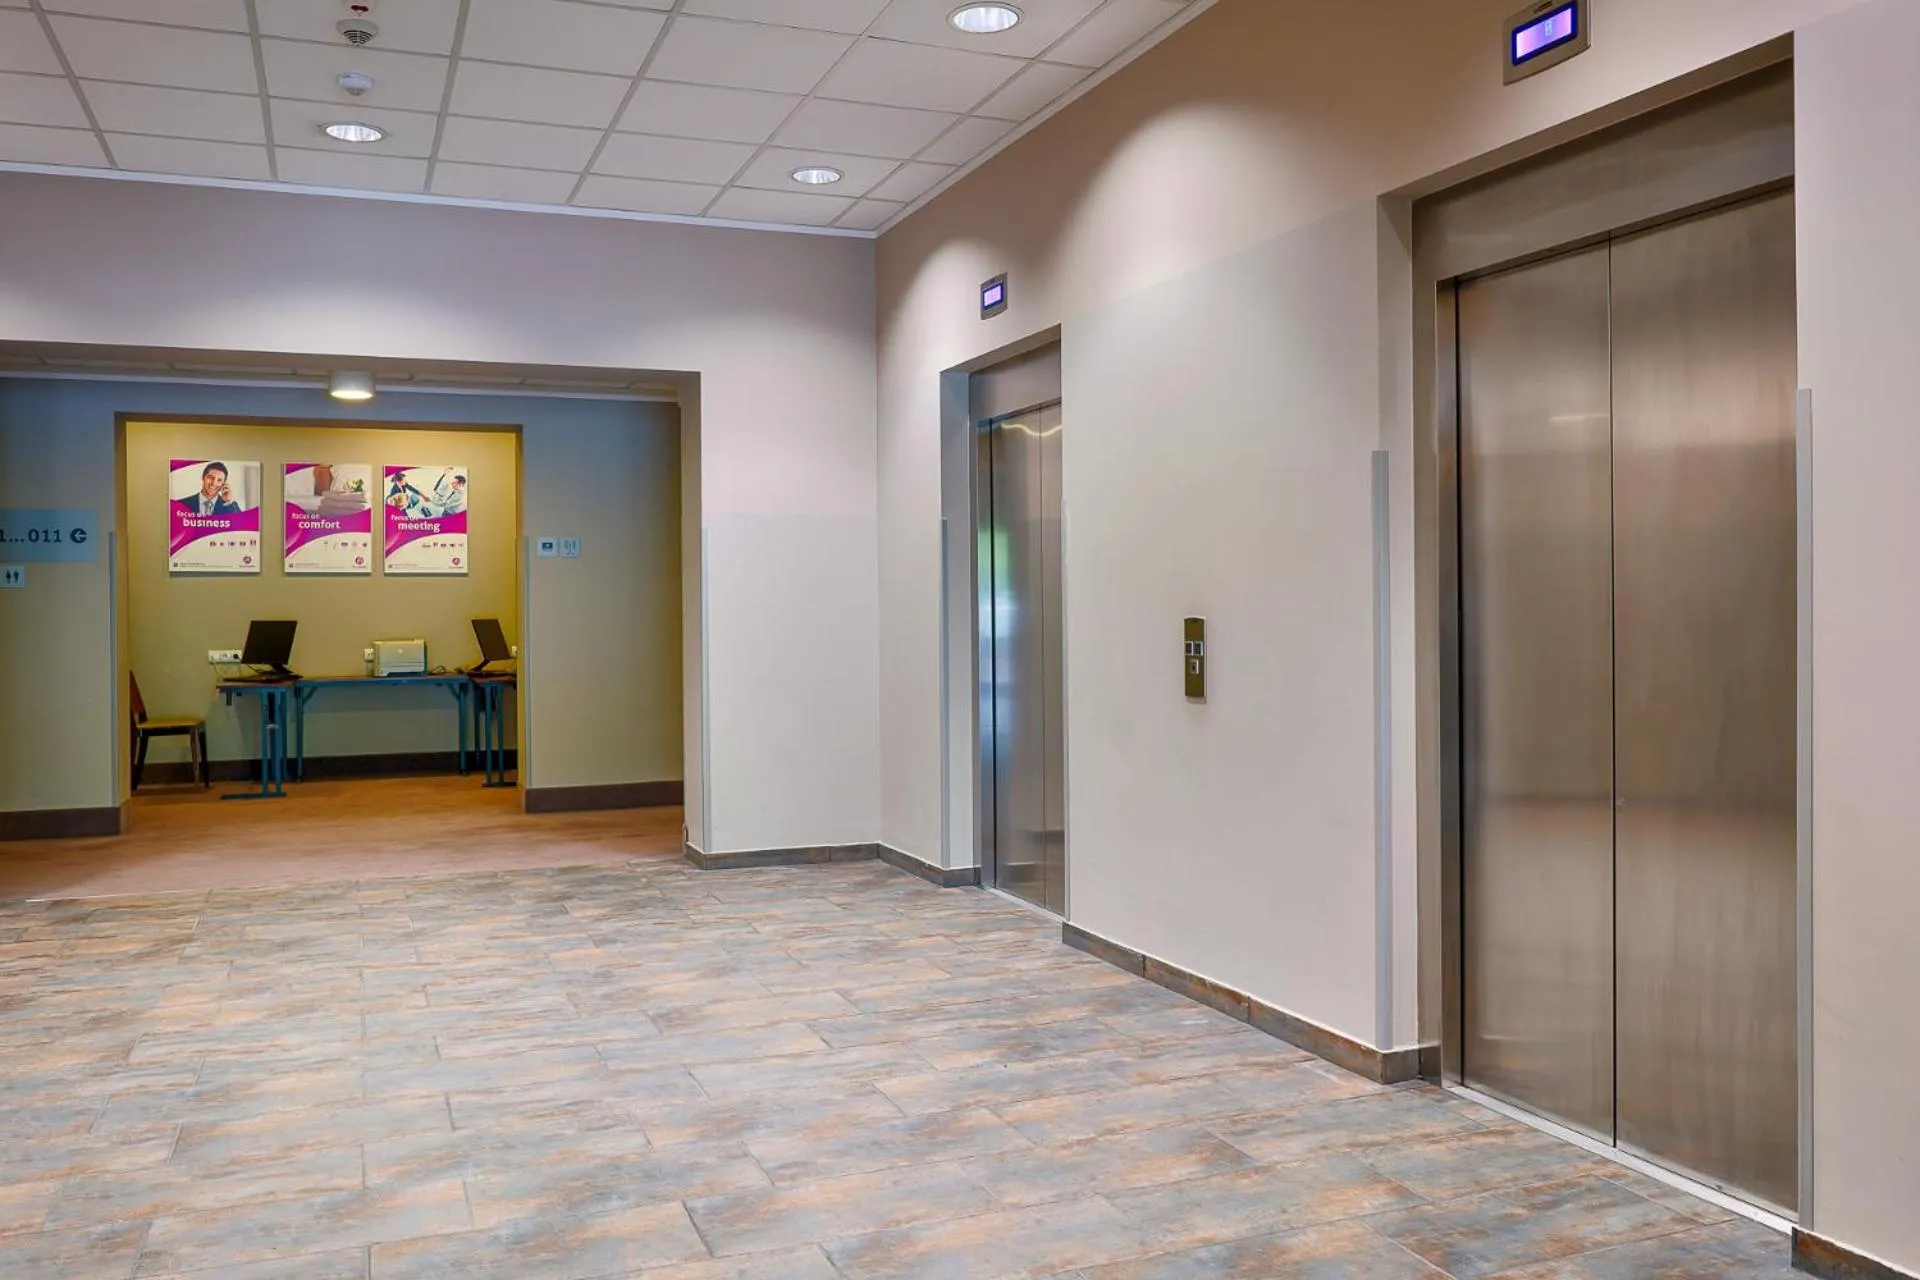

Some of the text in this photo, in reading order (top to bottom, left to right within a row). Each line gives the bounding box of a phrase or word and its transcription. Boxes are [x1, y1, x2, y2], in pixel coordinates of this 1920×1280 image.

[177, 510, 195, 518] focus
[183, 518, 231, 528] business
[299, 519, 340, 529] comfort
[398, 521, 441, 533] meeting
